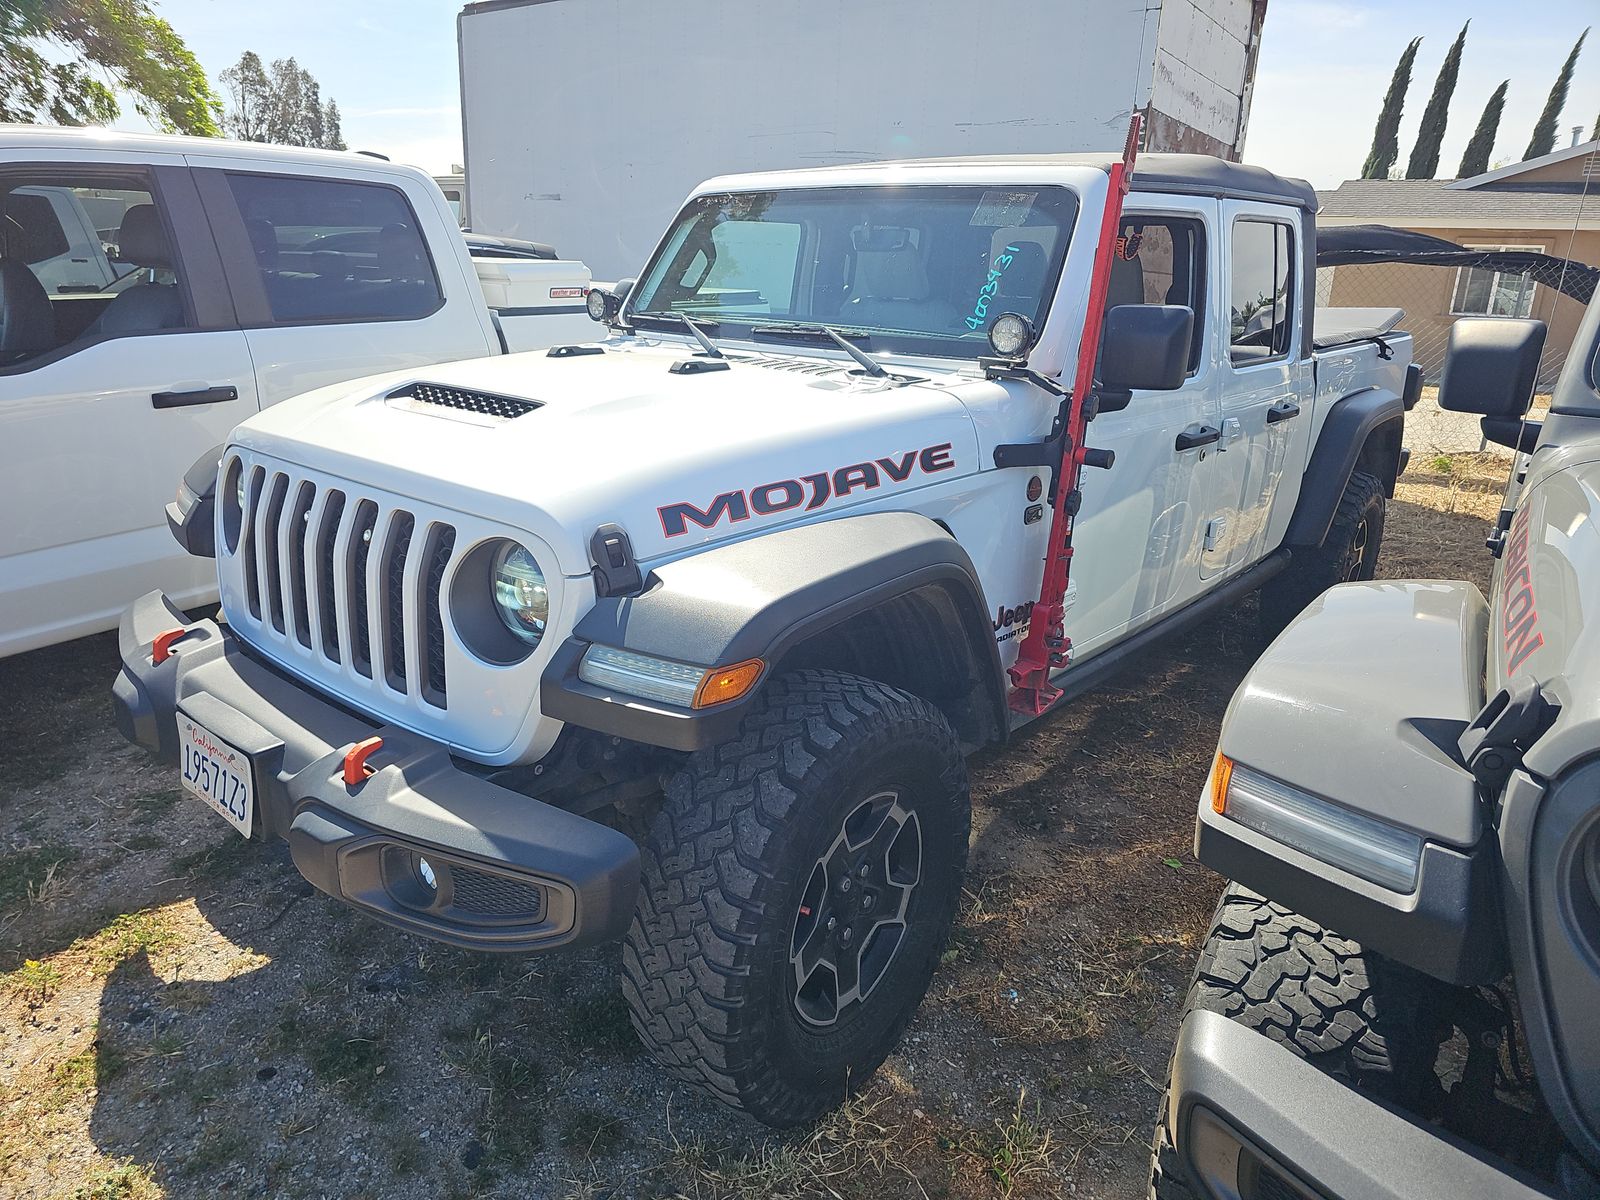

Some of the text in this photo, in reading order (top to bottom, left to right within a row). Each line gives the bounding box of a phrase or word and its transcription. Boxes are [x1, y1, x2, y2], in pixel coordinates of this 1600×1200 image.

[657, 442, 956, 538] MOJAVE
[993, 600, 1035, 631] Jeep
[1504, 501, 1544, 678] RUBICON
[184, 743, 247, 822] 19571Z3
[192, 727, 237, 770] California
